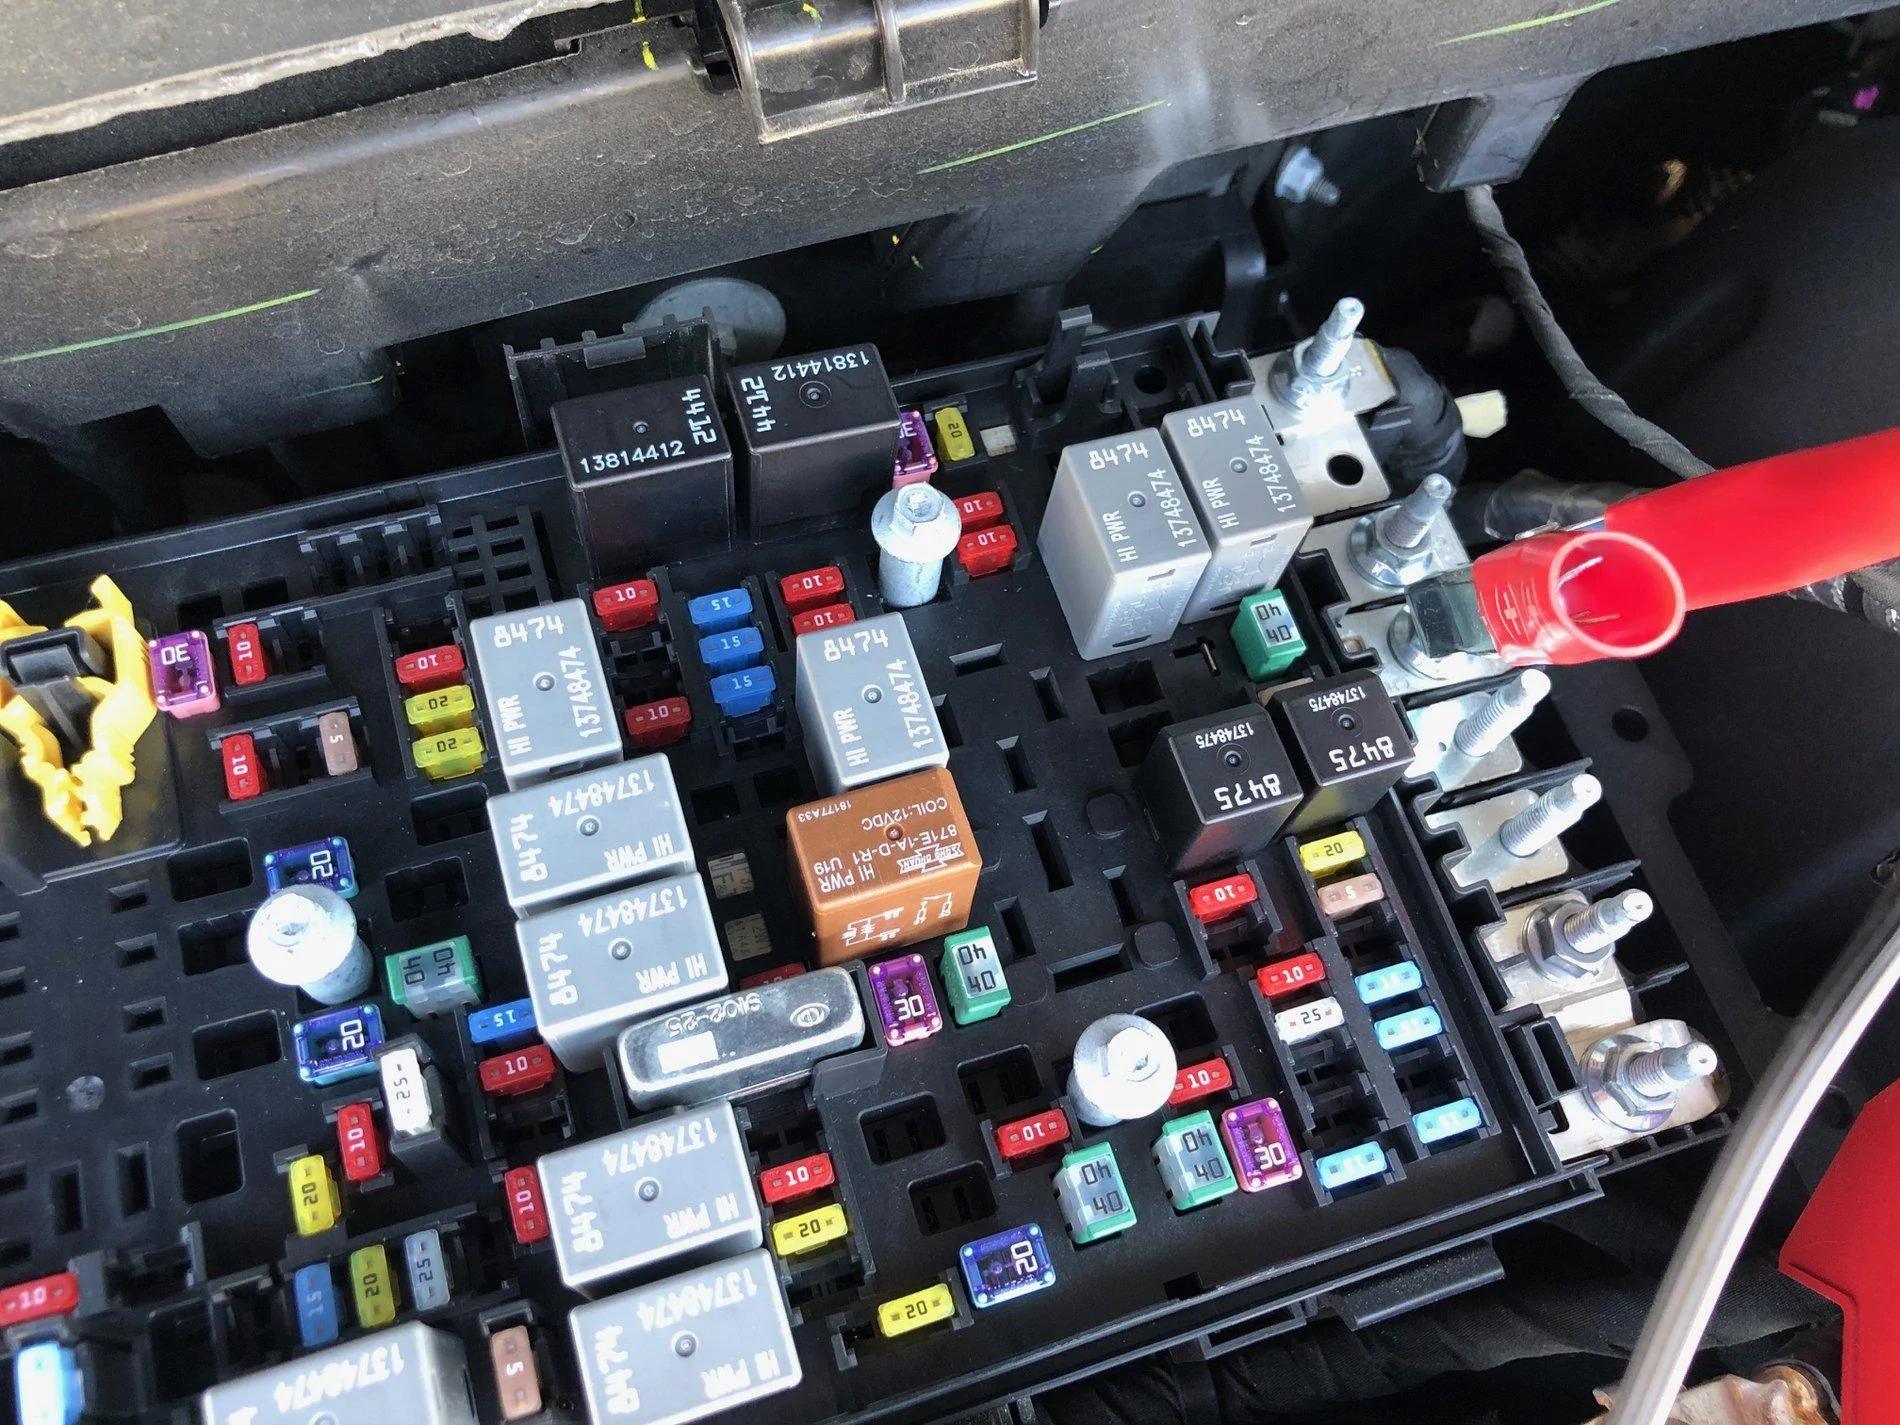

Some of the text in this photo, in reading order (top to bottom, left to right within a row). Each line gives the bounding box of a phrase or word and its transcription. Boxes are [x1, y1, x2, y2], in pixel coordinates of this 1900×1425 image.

[771, 350, 870, 382] 13814412
[681, 388, 717, 445] 4412
[741, 376, 777, 433] 4412
[948, 423, 962, 438] 20
[1187, 408, 1246, 438] 8474
[580, 441, 686, 474] 13814412
[1089, 442, 1149, 471] 8474
[1245, 434, 1296, 513] 13748474
[963, 500, 983, 514] 10
[1147, 467, 1197, 548] 13748474
[1202, 477, 1239, 529] HI PWR
[977, 531, 997, 546] 10
[1102, 510, 1139, 563] HI PWR
[802, 574, 823, 589] 10
[615, 587, 637, 601] 10
[711, 597, 733, 611] 15
[813, 612, 834, 627] 10
[1255, 603, 1282, 621] 40
[493, 615, 564, 648] 8474
[720, 635, 741, 649] 15
[1266, 624, 1290, 643] 40
[161, 642, 191, 666] 30
[237, 641, 252, 662] 10
[824, 628, 888, 662] 8474
[417, 656, 440, 671] 10
[558, 645, 603, 738] 13748474
[732, 674, 753, 689] 15
[428, 695, 448, 711] 20
[886, 658, 934, 749] 13748474
[1308, 686, 1366, 713] 13748475
[648, 705, 669, 720] 10
[497, 694, 533, 757] HI PWR
[832, 706, 870, 767] HI PWR
[1195, 722, 1254, 749] 13748475
[329, 733, 343, 744] 5
[436, 738, 457, 753] 20
[231, 755, 248, 776] 10
[1329, 736, 1395, 772] 8475
[548, 769, 655, 818] 13748474
[1214, 773, 1281, 810] 8475
[798, 800, 851, 822] 18177A33
[510, 813, 549, 882] 8474
[604, 833, 674, 872] HI PWR
[1324, 842, 1343, 856] 20
[309, 849, 333, 879] 20
[813, 857, 843, 874] U19
[820, 864, 875, 893] HI PWR
[1214, 885, 1236, 901] 10
[577, 885, 688, 937] 13748474
[433, 947, 456, 977] 40
[685, 953, 708, 979] HI
[958, 944, 986, 965] 40
[403, 955, 425, 985] 40
[539, 932, 579, 1006] 8474
[967, 970, 996, 992] 40
[1282, 966, 1302, 984] 10
[494, 1010, 516, 1027] 15
[894, 994, 925, 1021] 30
[1300, 1008, 1322, 1024] 25
[340, 1019, 365, 1051] 20
[505, 1056, 529, 1075] 10
[394, 1078, 411, 1100] 25
[1186, 1069, 1210, 1088] 10
[347, 1128, 365, 1152] 10
[1022, 1122, 1045, 1142] 10
[1182, 1129, 1213, 1152] 40
[1254, 1142, 1286, 1170] 30
[785, 1166, 809, 1186] 10
[1081, 1162, 1112, 1185] 40
[1194, 1157, 1225, 1182] 40
[302, 1183, 319, 1206] 20
[515, 1190, 534, 1215] 10
[1092, 1190, 1124, 1215] 40
[715, 1193, 739, 1223] HI
[798, 1219, 822, 1238] 20
[1010, 1240, 1038, 1276] 20
[416, 1258, 432, 1283] 25
[19, 1287, 48, 1309] 10
[363, 1274, 379, 1298] 20
[307, 1291, 323, 1316] 15
[905, 1301, 928, 1319] 20
[506, 1361, 523, 1376] 5
